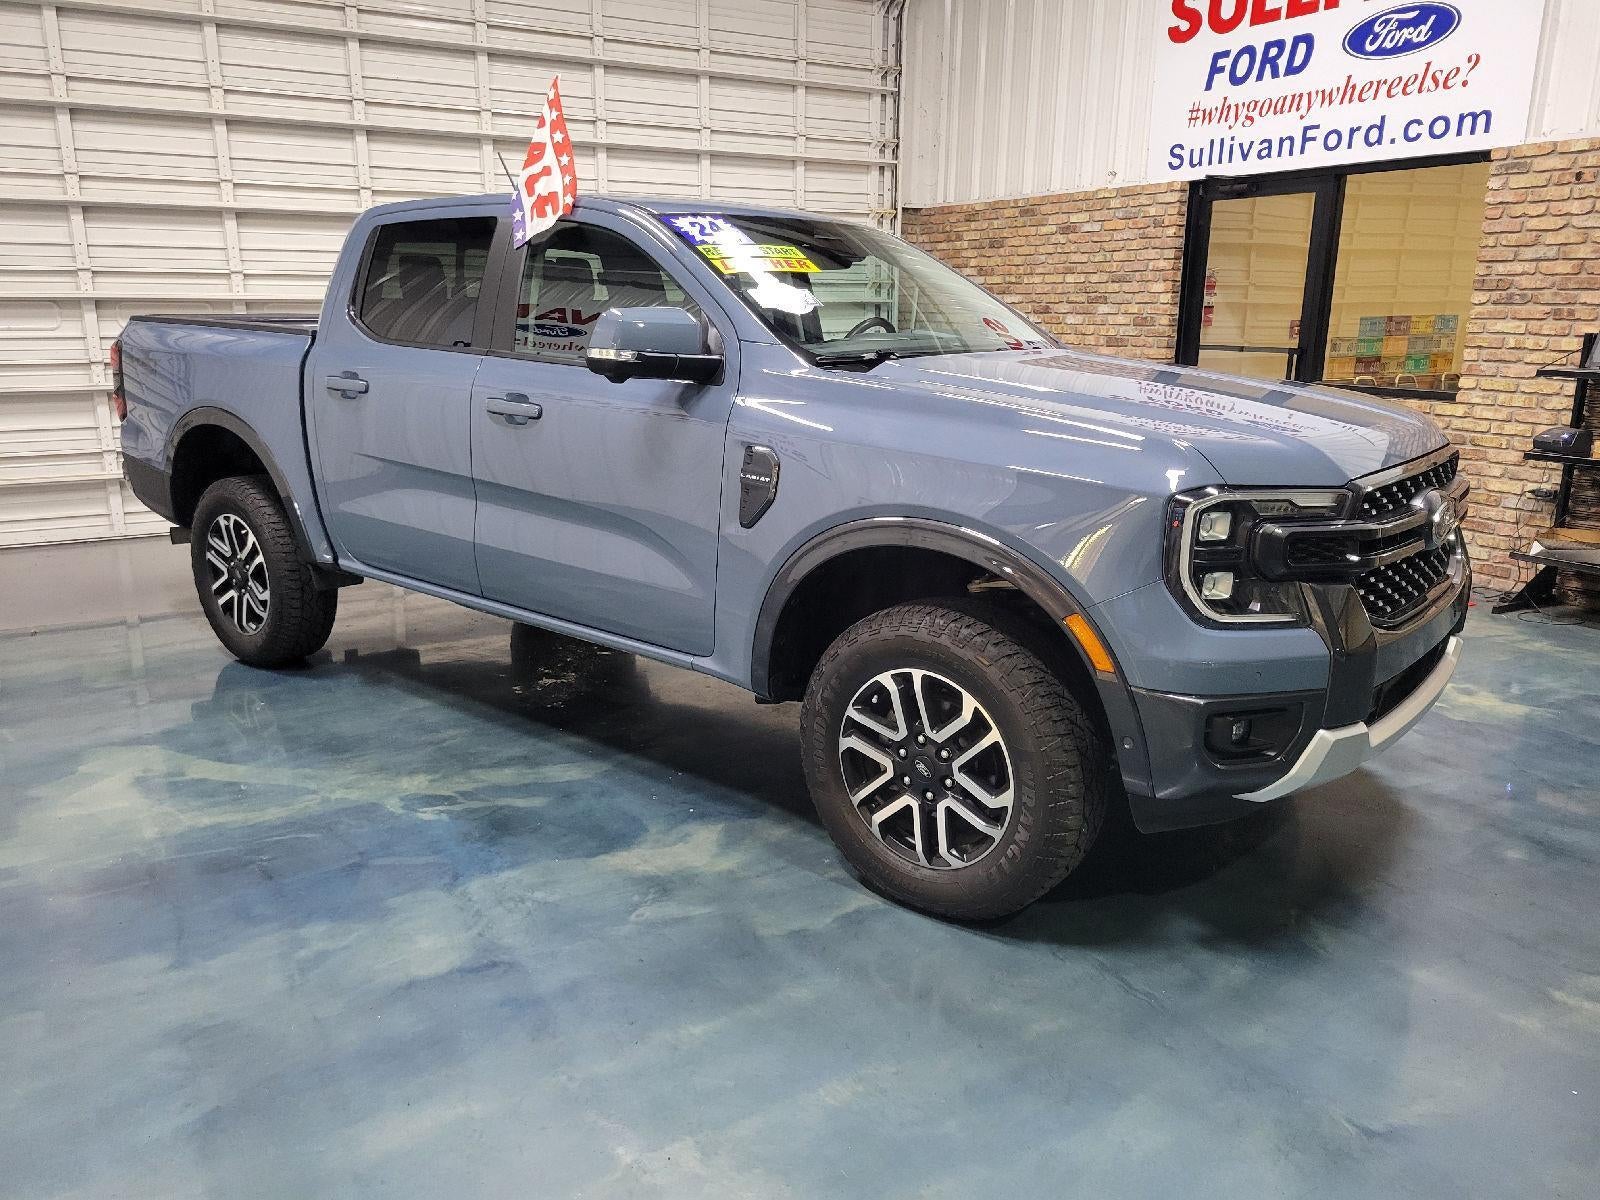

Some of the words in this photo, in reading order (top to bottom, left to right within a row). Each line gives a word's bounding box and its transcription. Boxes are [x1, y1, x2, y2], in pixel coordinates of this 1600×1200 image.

[1366, 10, 1438, 52] Ford
[1205, 33, 1315, 91] FORD
[1187, 53, 1481, 130] #whygoanywhereelse?
[521, 113, 560, 223] ALE
[1168, 109, 1492, 171] SullivanFord.com
[720, 259, 812, 271] LHER
[740, 472, 771, 483] LARIAT
